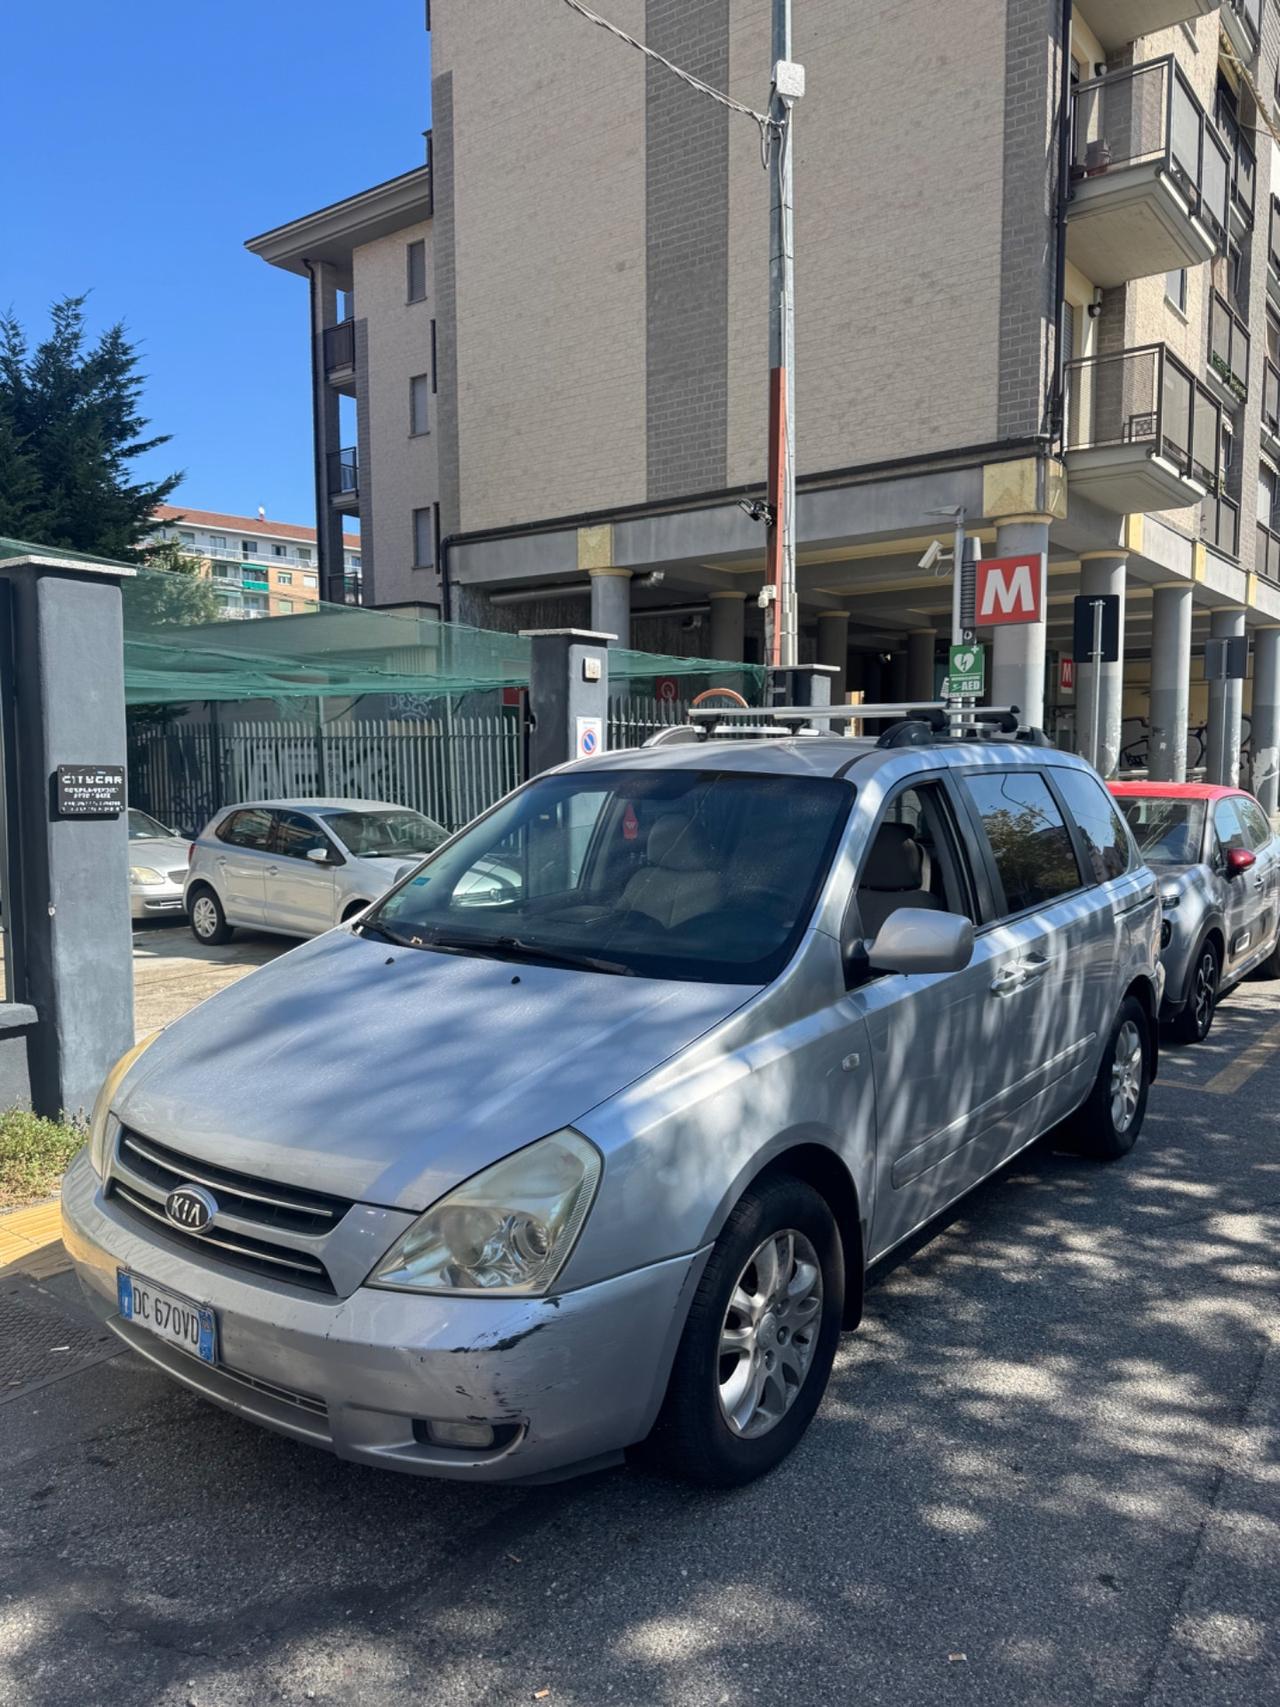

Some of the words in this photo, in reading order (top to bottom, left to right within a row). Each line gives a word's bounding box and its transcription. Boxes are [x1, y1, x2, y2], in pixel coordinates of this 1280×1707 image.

[981, 565, 1035, 615] M
[961, 681, 980, 690] AED
[1062, 662, 1072, 683] M
[170, 1195, 201, 1226] KIA
[133, 1286, 150, 1319] DC
[155, 1297, 199, 1344] 670VD
